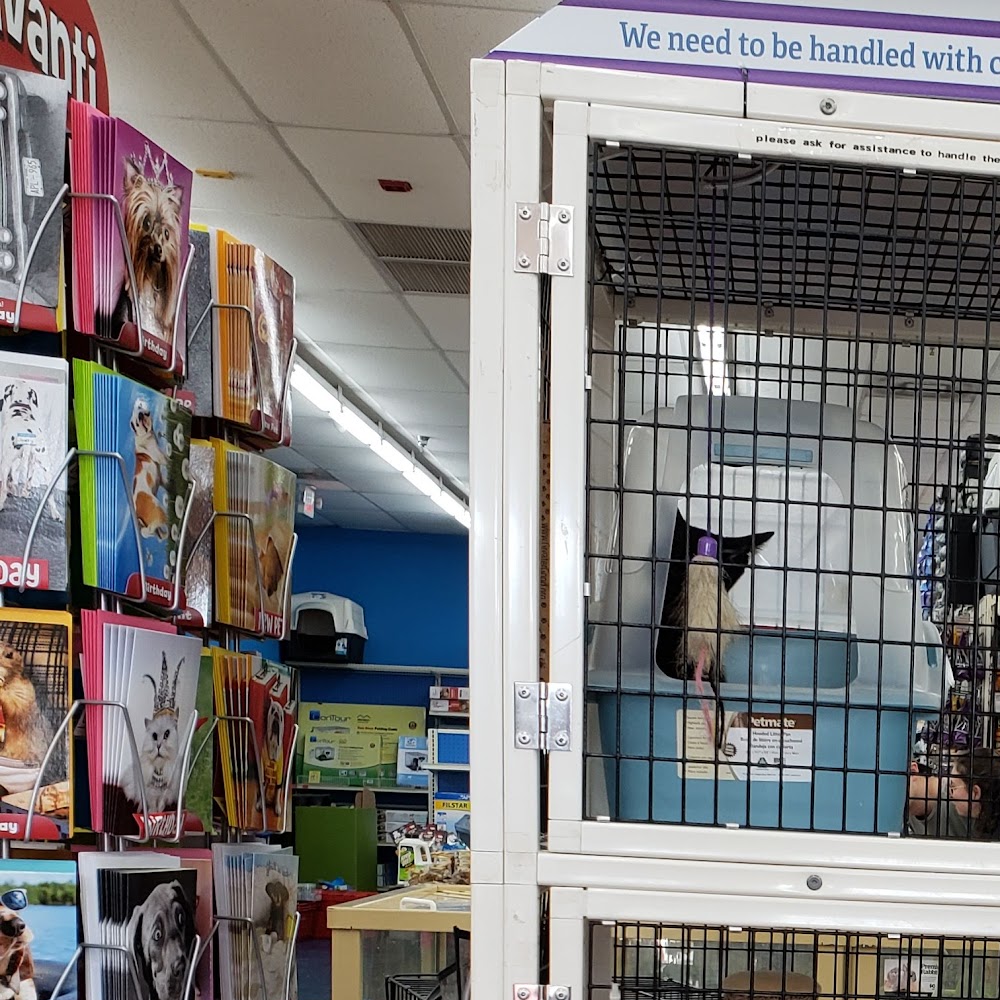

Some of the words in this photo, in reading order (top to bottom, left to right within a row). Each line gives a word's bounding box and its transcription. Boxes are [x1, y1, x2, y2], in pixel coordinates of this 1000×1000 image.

[619, 22, 660, 49] We
[668, 28, 731, 55] need
[739, 33, 764, 57] to
[772, 32, 802, 59] be
[810, 35, 915, 68] handled
[922, 45, 983, 73] with
[756, 135, 796, 148] please
[830, 141, 846, 149] for
[853, 145, 916, 155] assistance
[938, 151, 976, 160] handle
[749, 716, 796, 729] etmate
[441, 801, 468, 809] FILSTAR
